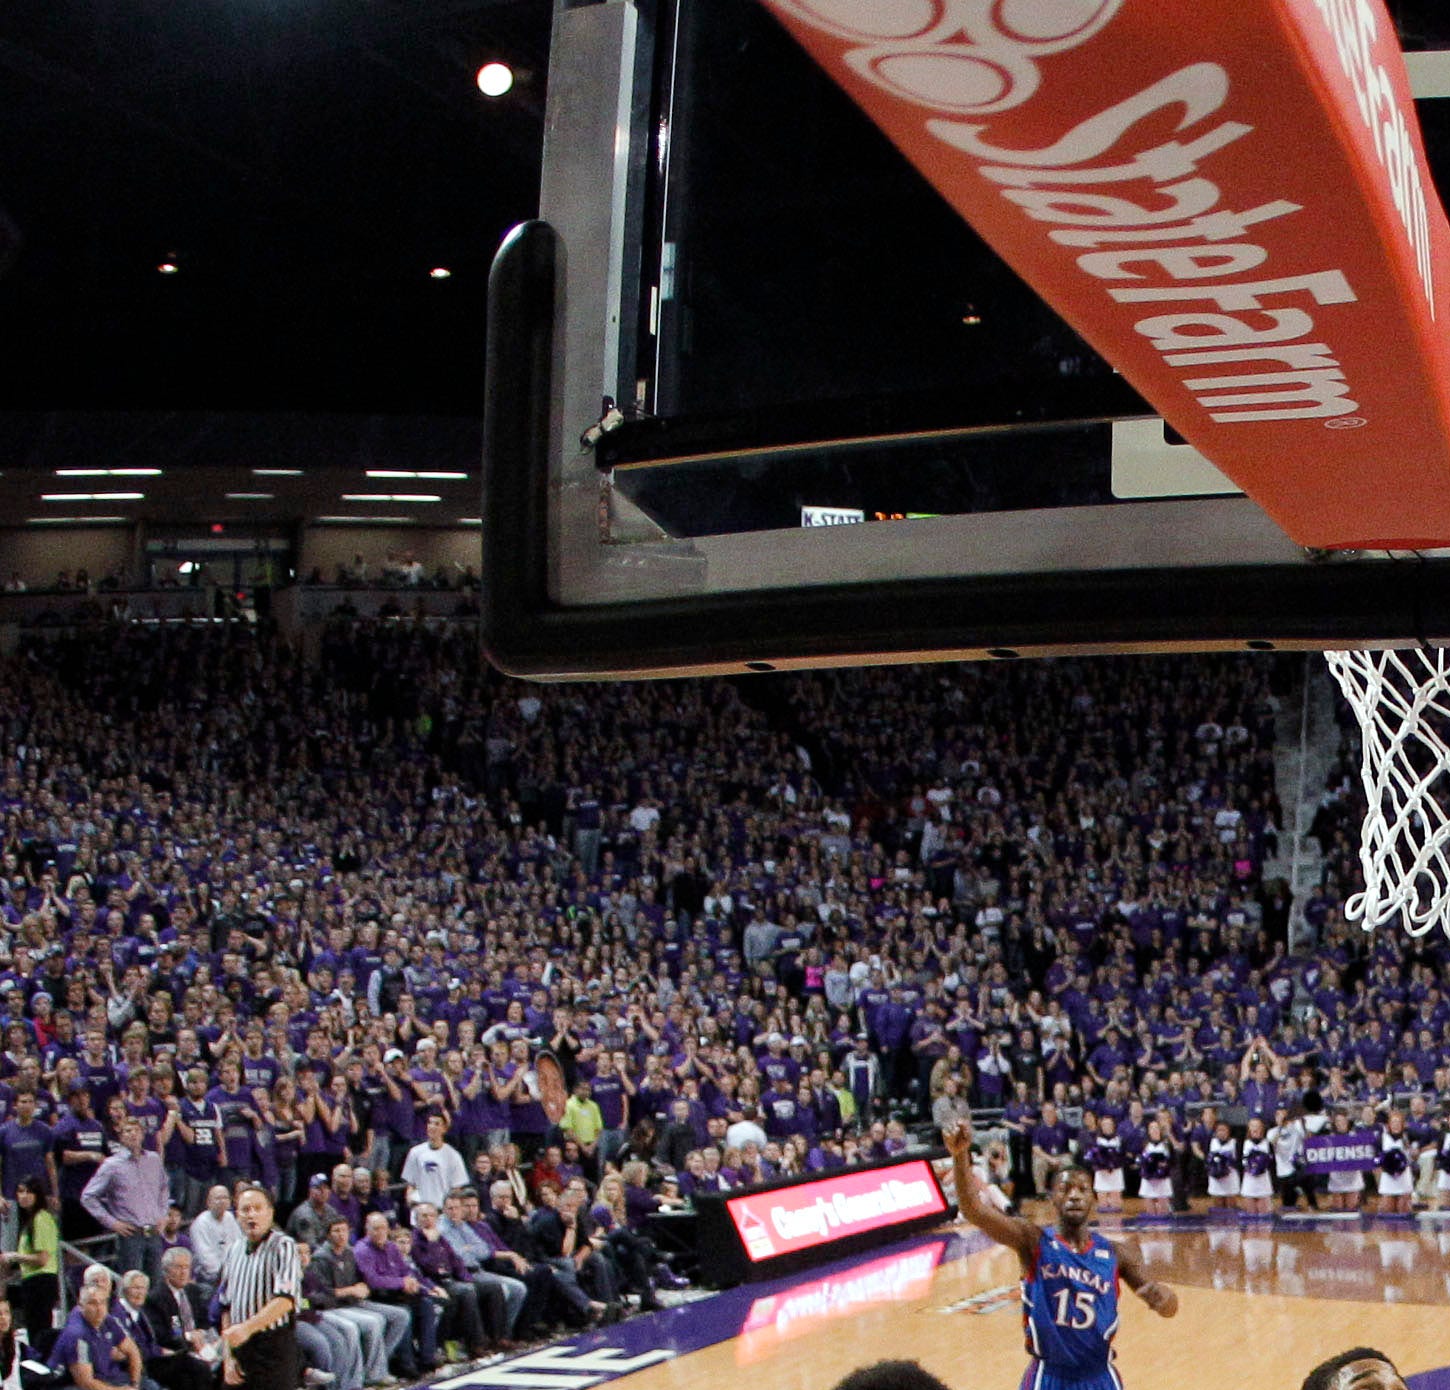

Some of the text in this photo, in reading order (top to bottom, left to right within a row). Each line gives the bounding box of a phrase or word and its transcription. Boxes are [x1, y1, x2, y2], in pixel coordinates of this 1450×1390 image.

[1306, 1144, 1376, 1163] DEFENSE
[1041, 1262, 1111, 1296] KANSAS
[1053, 1287, 1097, 1331] 15
